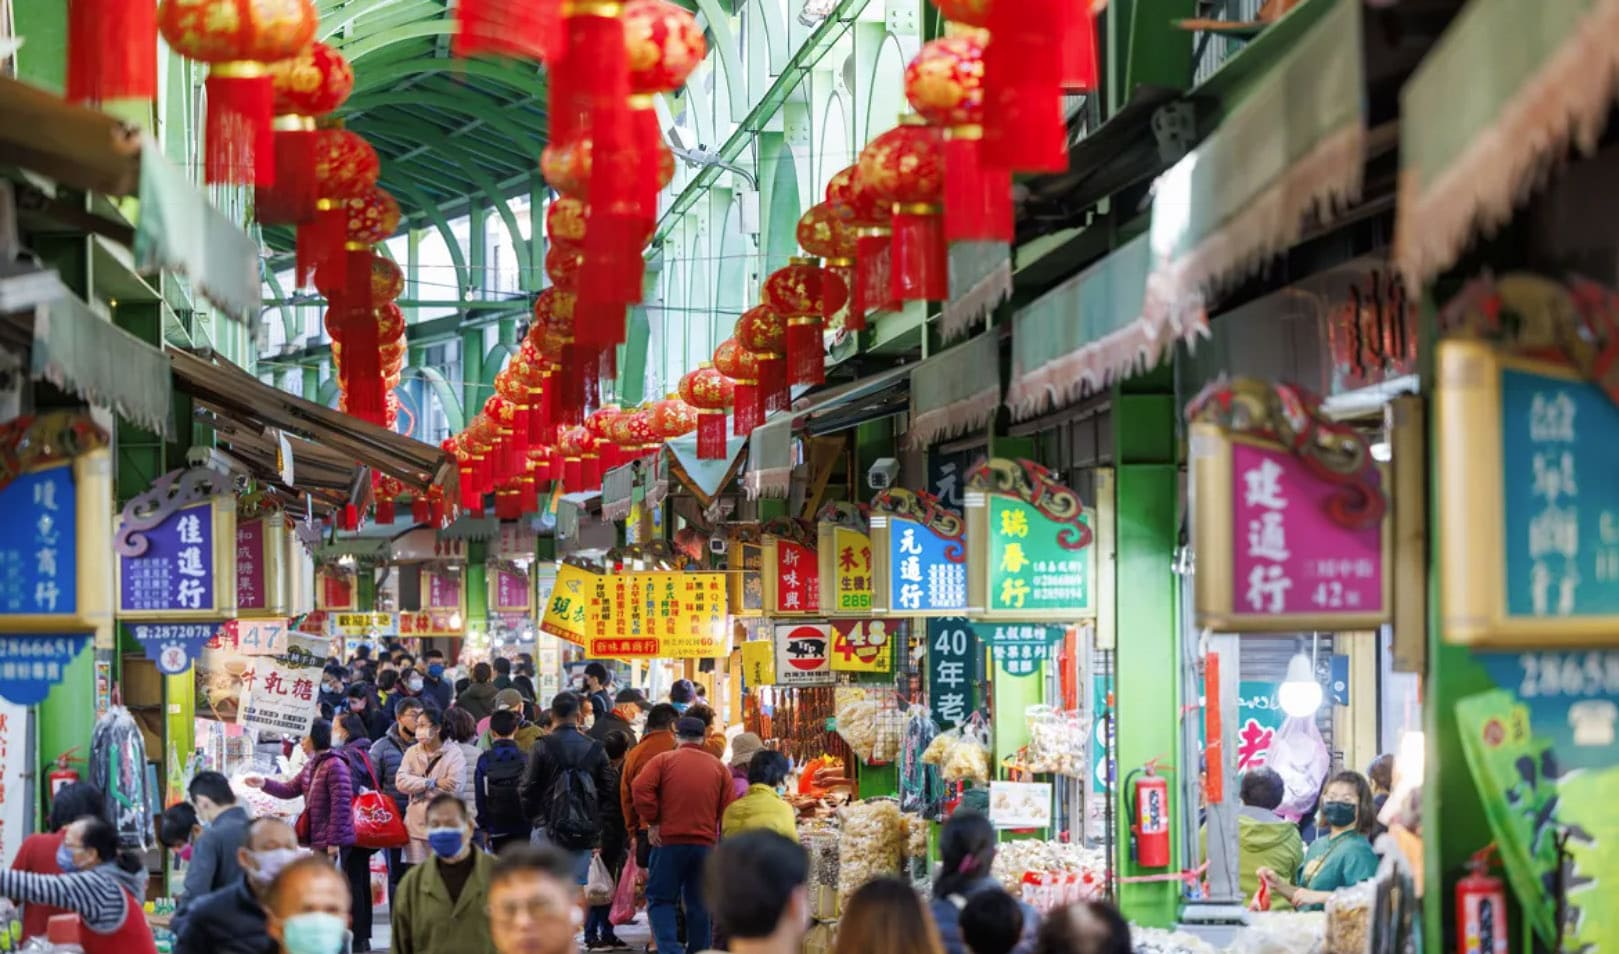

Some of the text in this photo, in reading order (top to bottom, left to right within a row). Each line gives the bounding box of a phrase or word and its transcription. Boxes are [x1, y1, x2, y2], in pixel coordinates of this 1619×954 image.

[177, 514, 206, 609] 佳進行
[783, 548, 800, 609] 新味興
[899, 529, 923, 608] 元通行
[842, 594, 872, 607] 285
[243, 625, 281, 649] 47
[847, 619, 886, 646] 48
[935, 617, 967, 724] 40年老
